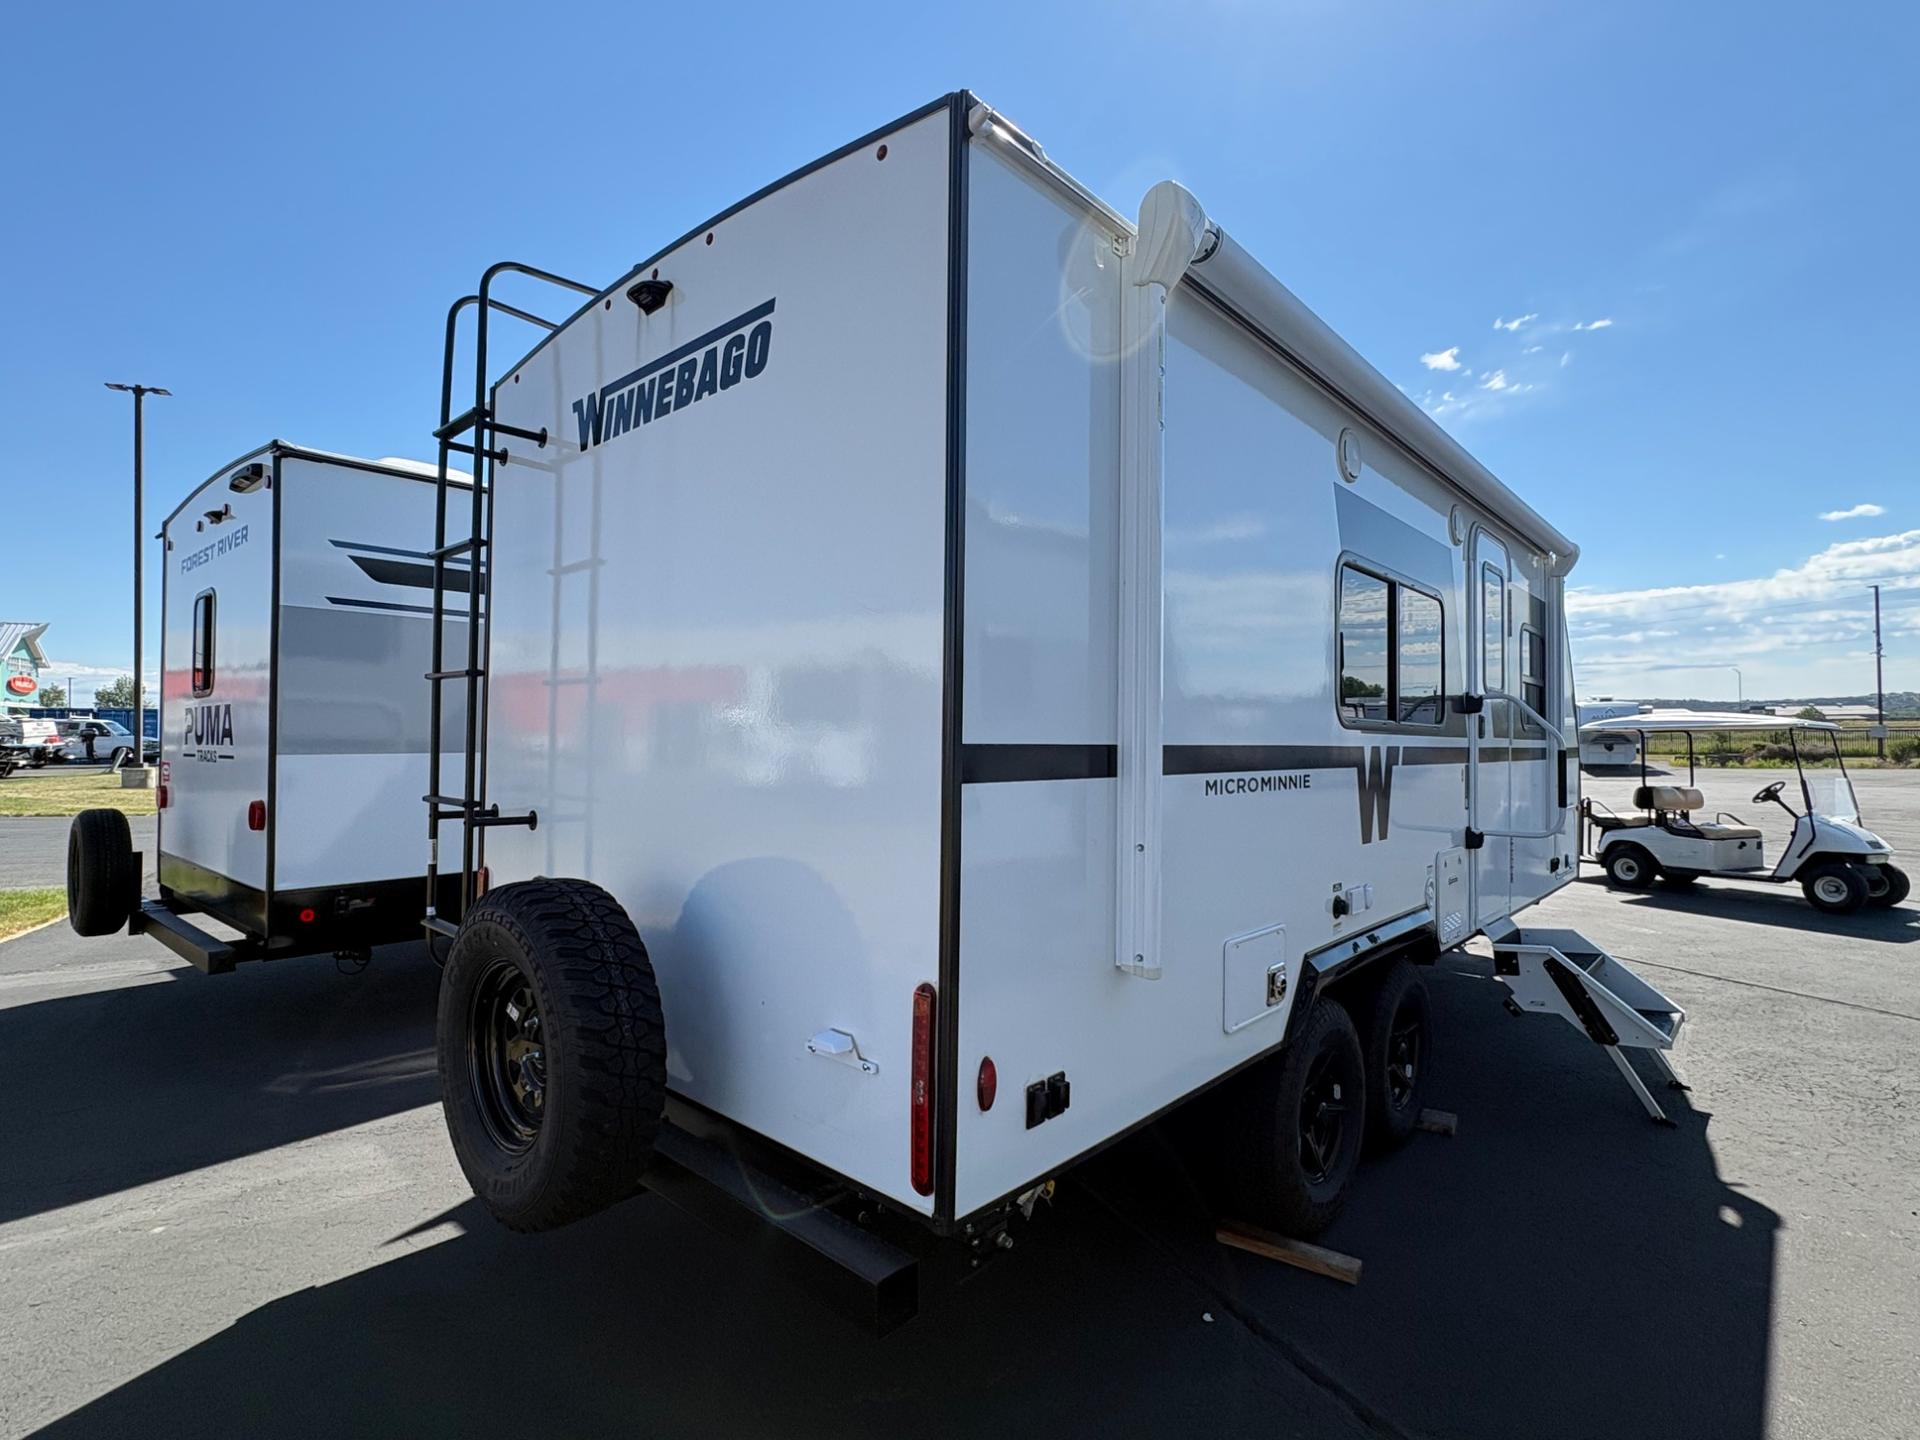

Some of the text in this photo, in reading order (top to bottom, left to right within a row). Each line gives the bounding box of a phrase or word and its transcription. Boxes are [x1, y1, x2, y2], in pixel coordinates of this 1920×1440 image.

[571, 298, 776, 452] WINNEBAGO
[181, 525, 249, 574] FOREST RIVER
[184, 704, 233, 746] PUMA
[197, 750, 217, 763] TRACKS
[1205, 774, 1311, 796] MICROMINNIE
